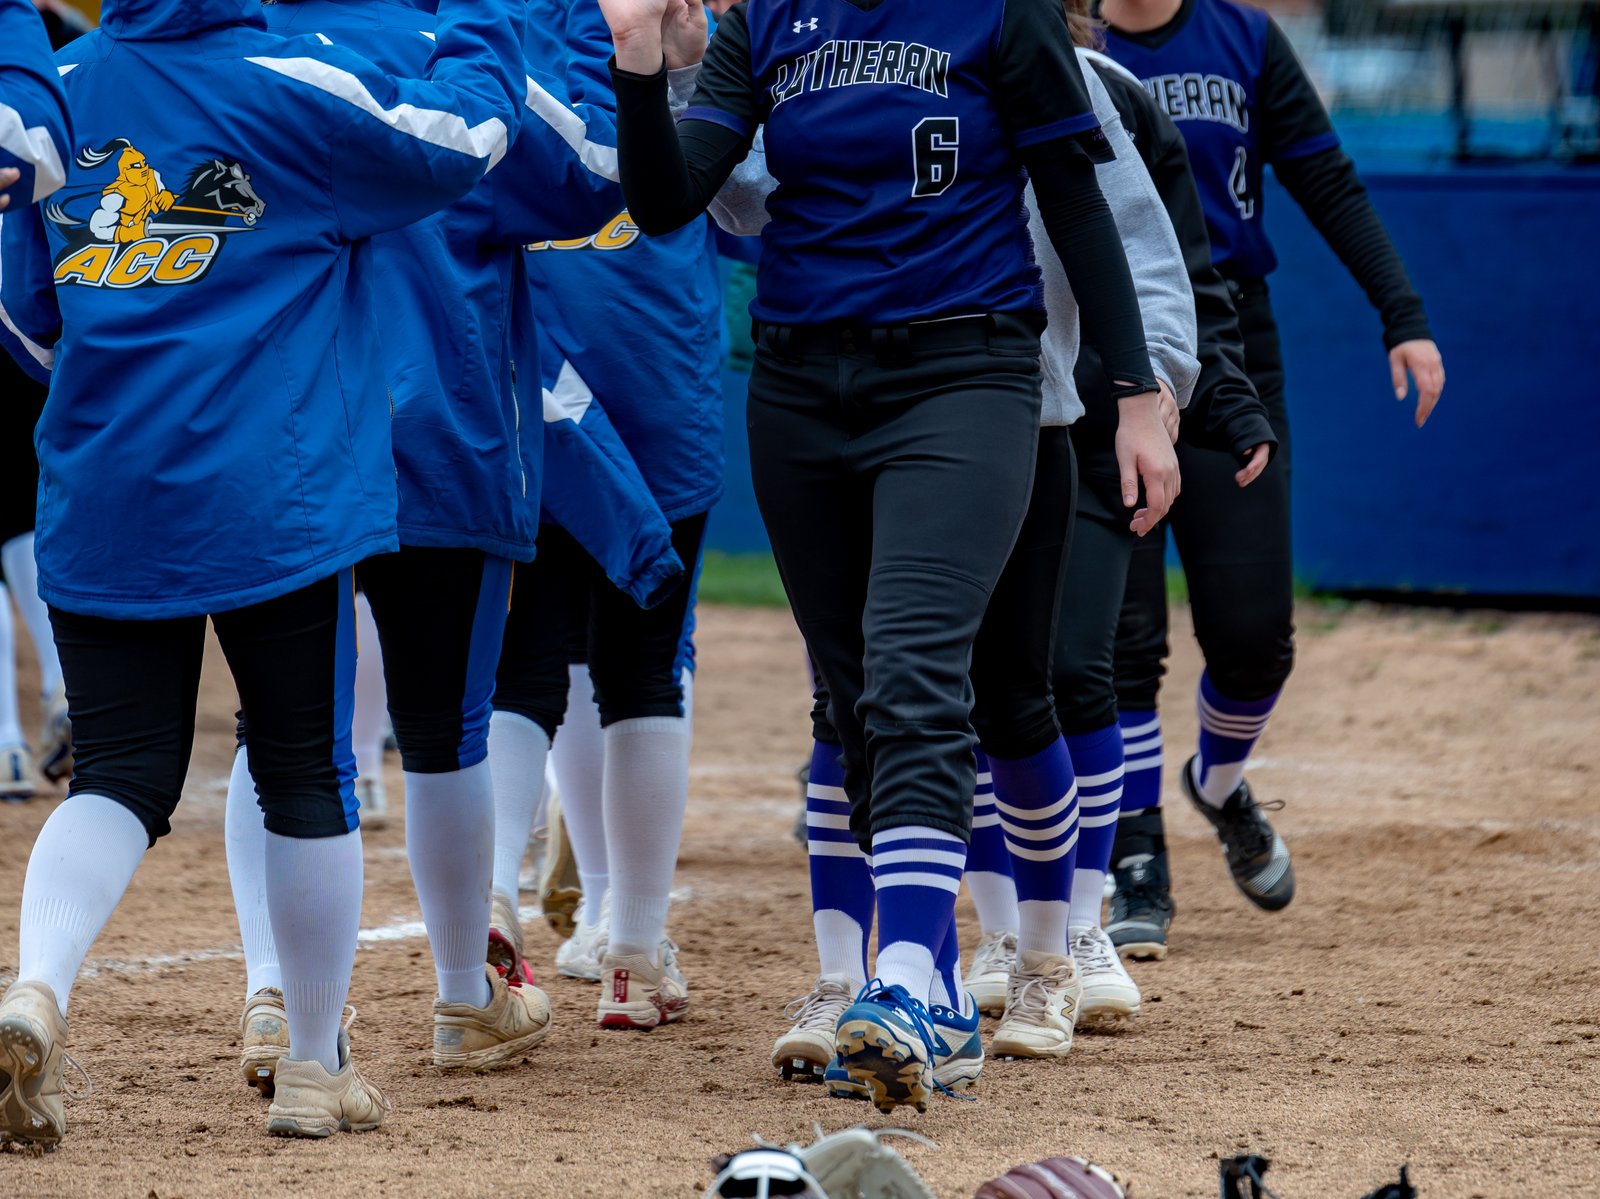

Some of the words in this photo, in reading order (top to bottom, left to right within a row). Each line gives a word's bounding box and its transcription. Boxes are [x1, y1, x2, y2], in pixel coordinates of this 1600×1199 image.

[911, 117, 959, 198] 6
[1228, 146, 1254, 220] 4
[54, 233, 219, 288] ACC
